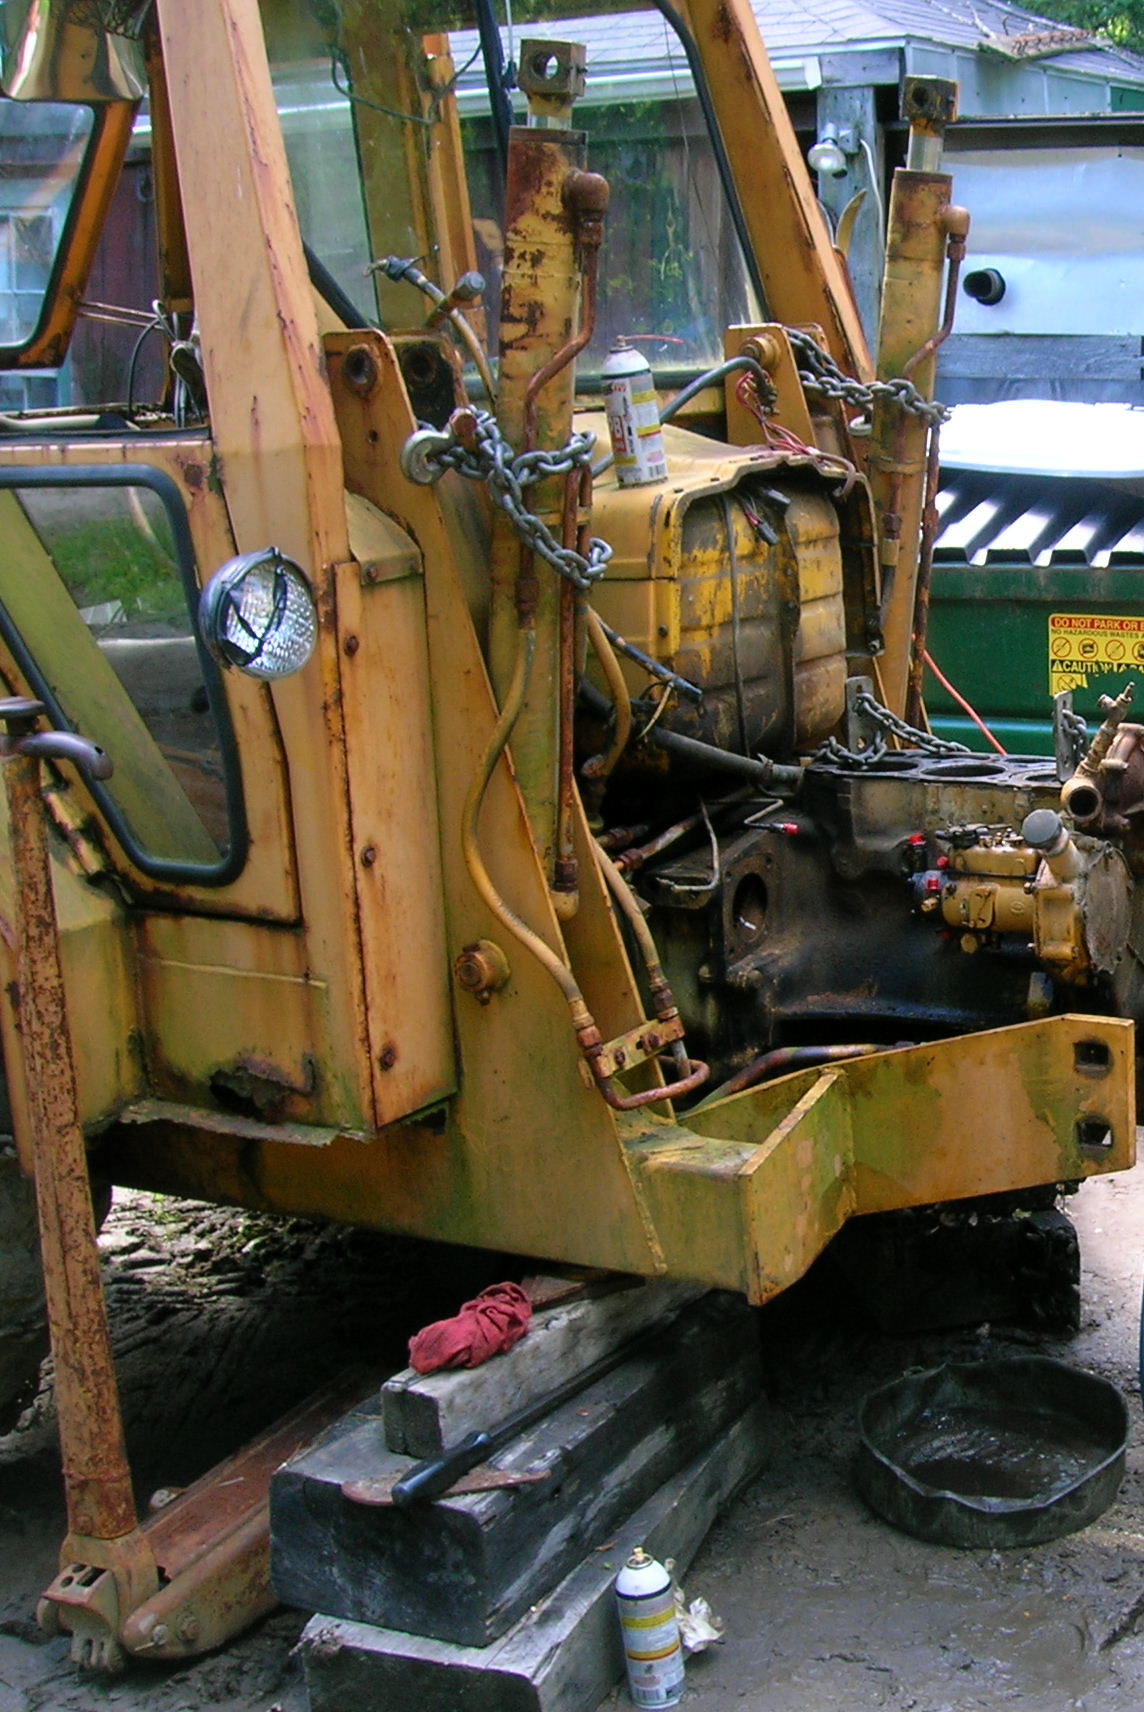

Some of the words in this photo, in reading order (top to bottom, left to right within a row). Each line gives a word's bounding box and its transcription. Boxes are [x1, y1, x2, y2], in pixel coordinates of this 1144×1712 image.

[1054, 618, 1067, 627] DO
[1071, 618, 1091, 628] NOT
[1094, 620, 1121, 629] PARK
[1122, 621, 1138, 630] OR
[1063, 629, 1109, 637] HAZARDOUS
[1109, 631, 1139, 639] WASTES
